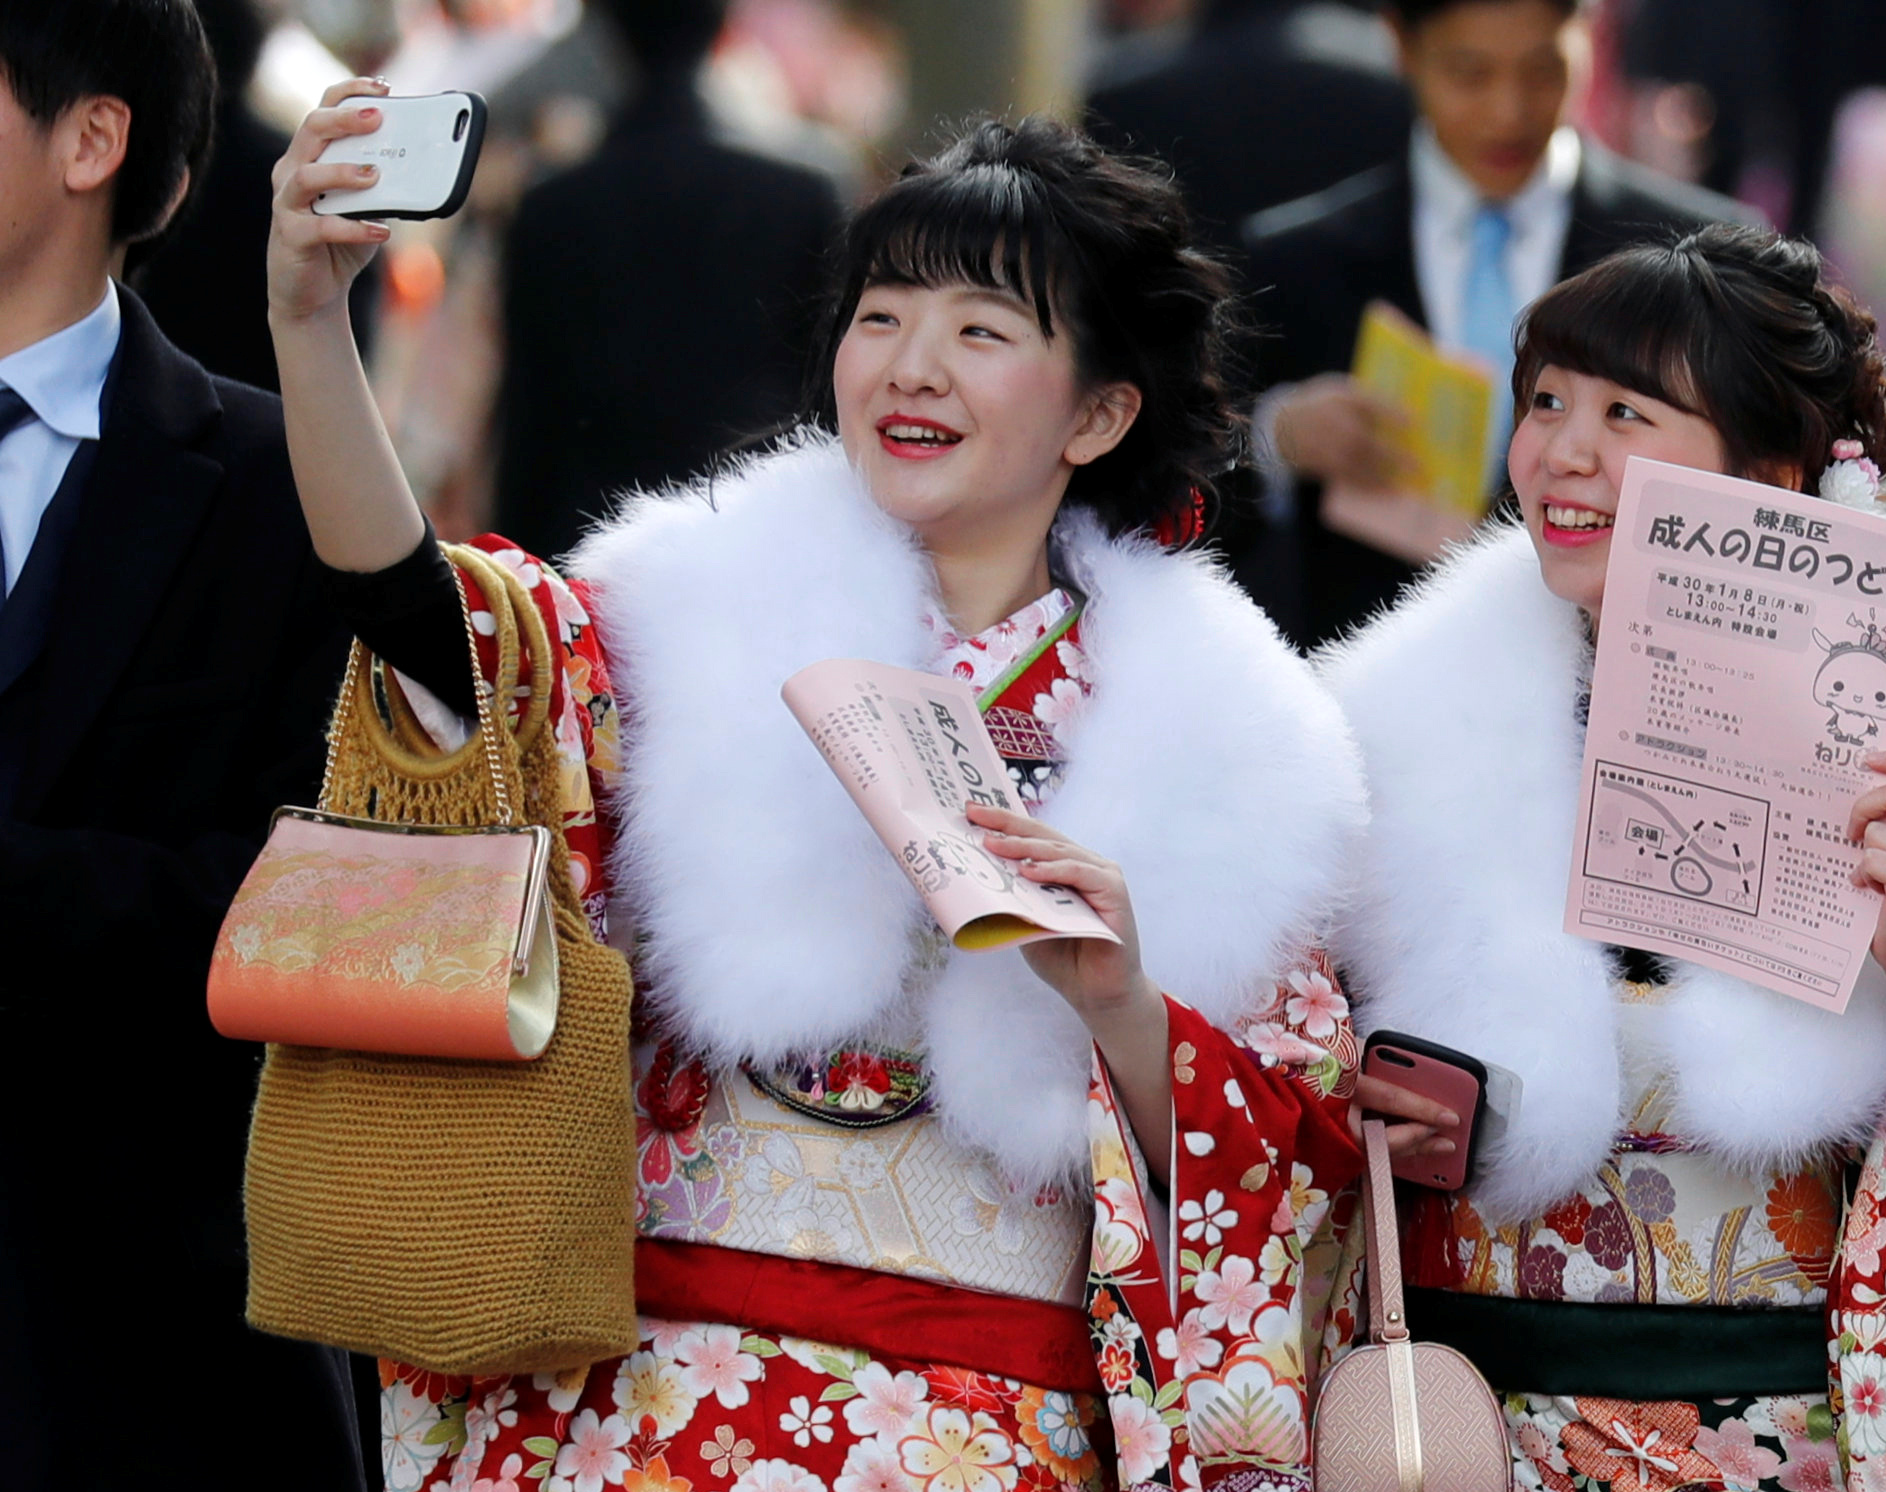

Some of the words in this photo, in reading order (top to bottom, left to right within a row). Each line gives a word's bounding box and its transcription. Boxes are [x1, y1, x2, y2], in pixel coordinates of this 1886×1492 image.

[1753, 507, 1832, 544] 練馬区
[1628, 622, 1652, 636] 次第
[1632, 826, 1658, 842] 会場
